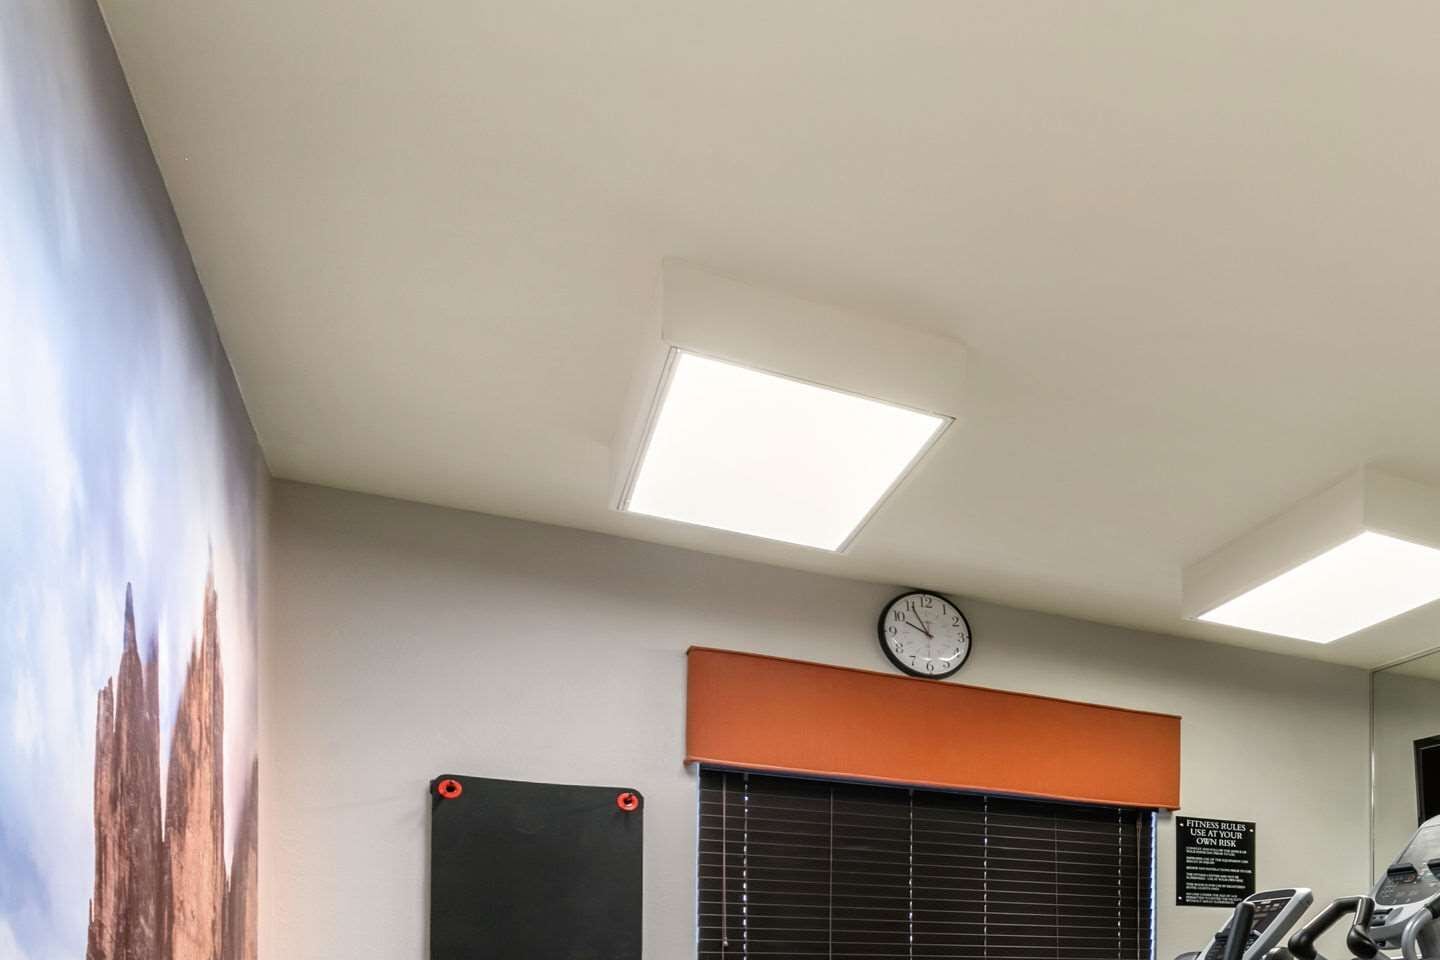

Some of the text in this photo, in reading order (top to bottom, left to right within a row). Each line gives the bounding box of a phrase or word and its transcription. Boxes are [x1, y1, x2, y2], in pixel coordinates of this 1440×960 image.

[920, 597, 933, 608] 12
[894, 610, 905, 622] 10
[952, 616, 960, 627] 2
[888, 626, 897, 637] 9
[958, 632, 965, 643] 3
[909, 655, 916, 666] 7
[926, 661, 935, 672] 6
[1186, 819, 1247, 832] FITNESS RULES
[1190, 829, 1243, 840] USE AT YOUR
[1196, 838, 1237, 848] OWN RISK
